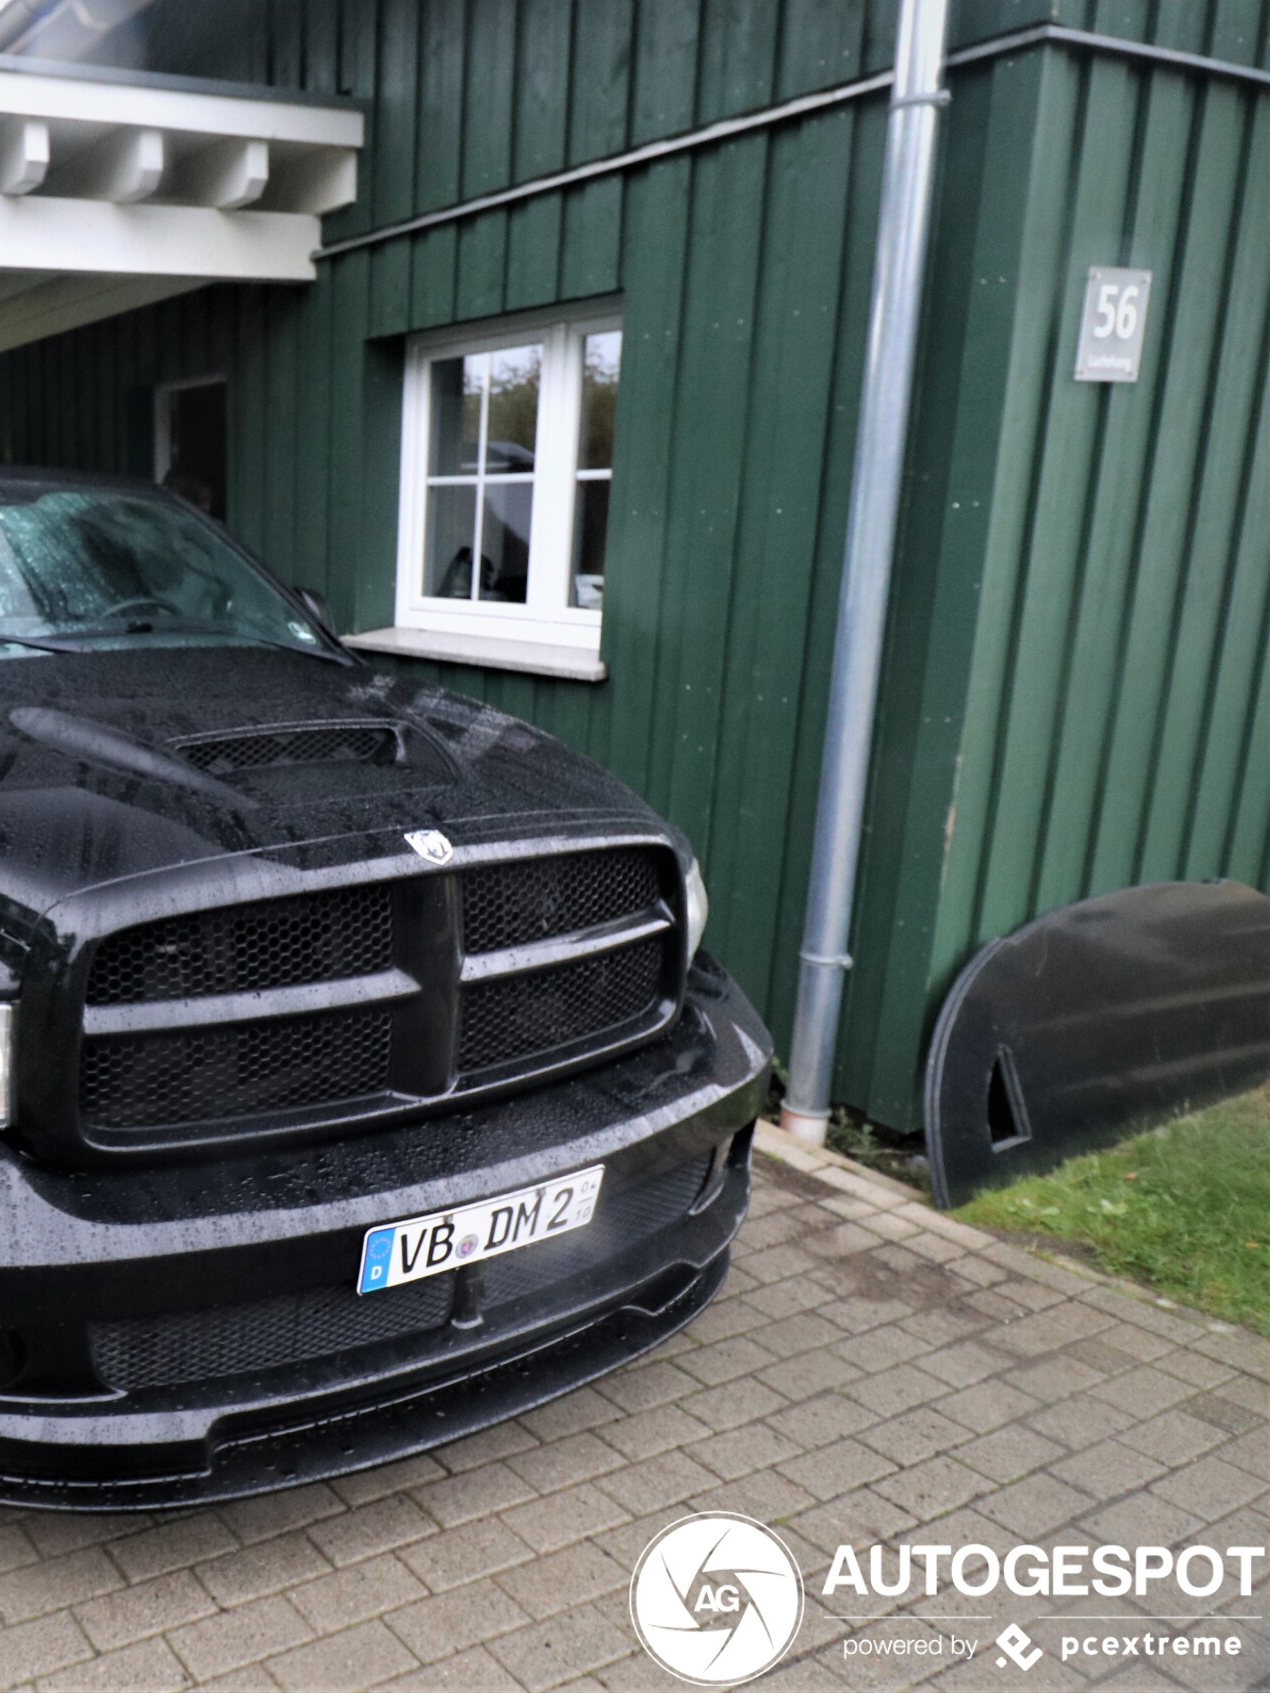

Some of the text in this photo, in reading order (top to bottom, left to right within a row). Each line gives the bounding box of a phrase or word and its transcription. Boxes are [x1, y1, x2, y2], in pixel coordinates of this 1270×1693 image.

[1093, 284, 1140, 339] 56
[400, 1187, 574, 1274] VB DM 2
[370, 1265, 382, 1280] D
